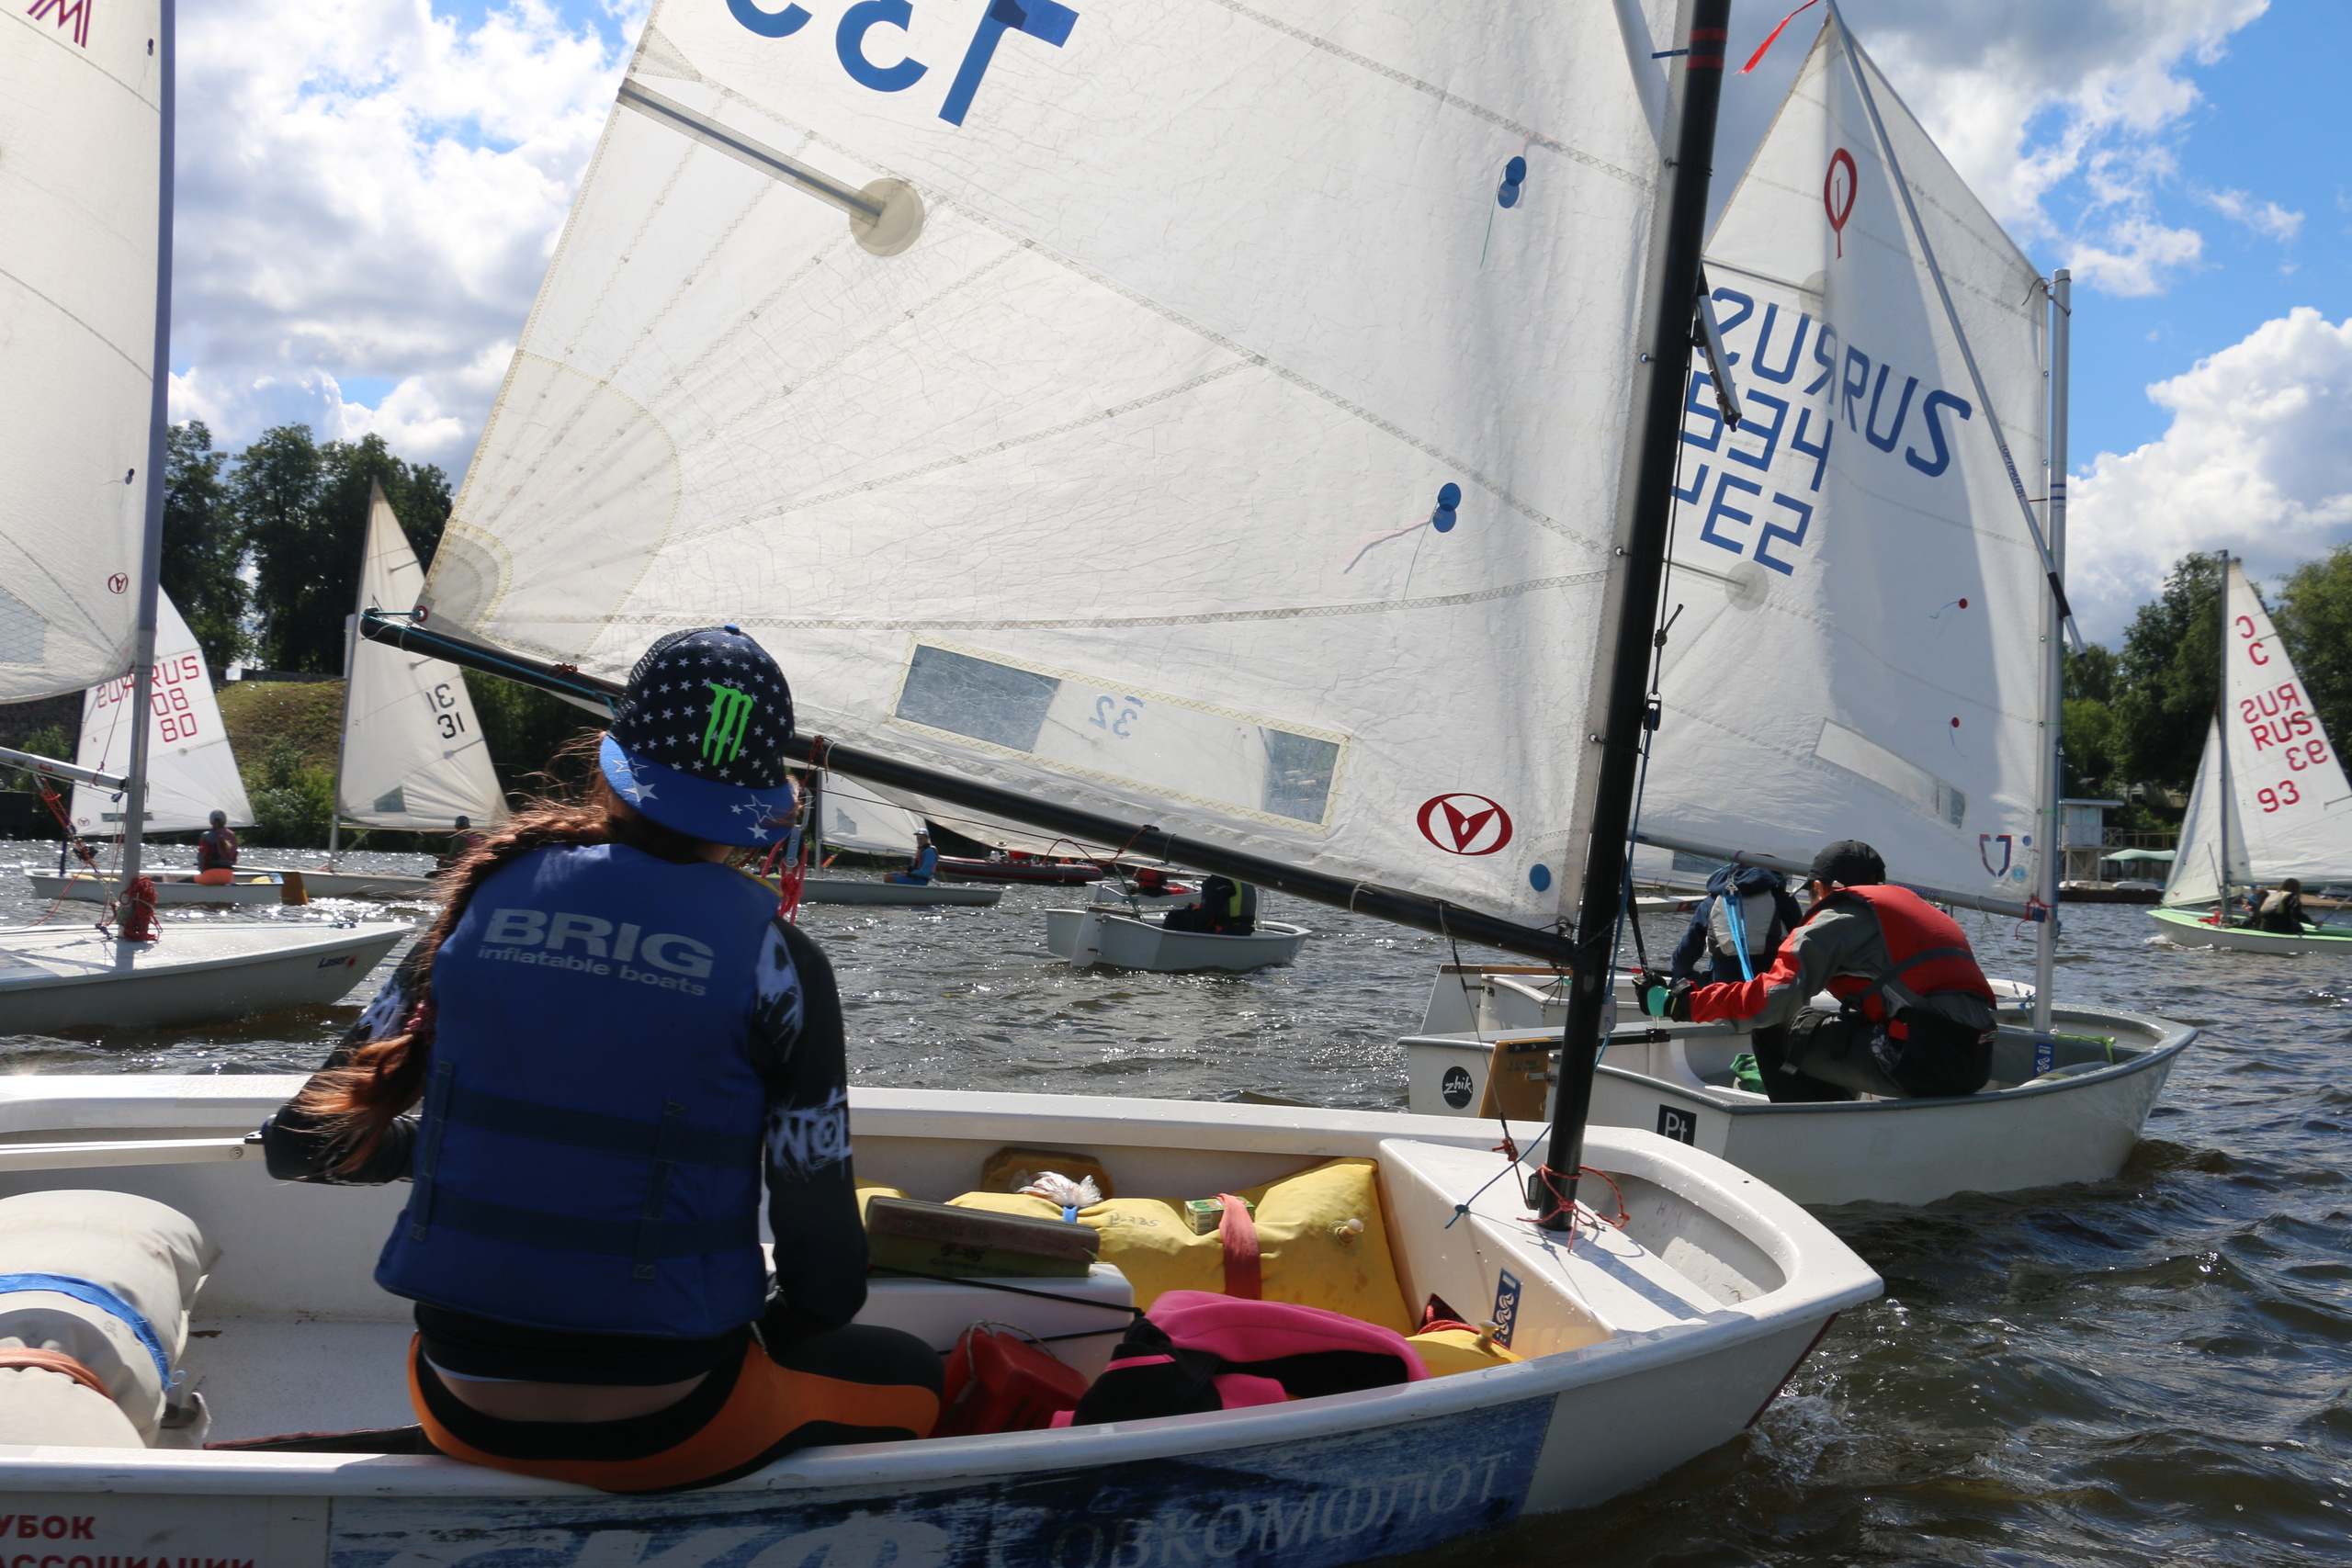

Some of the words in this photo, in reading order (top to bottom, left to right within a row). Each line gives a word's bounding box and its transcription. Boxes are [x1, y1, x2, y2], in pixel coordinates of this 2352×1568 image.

[1841, 344, 1973, 478] RUS
[2002, 447, 2025, 496] OPTIPARTS
[2248, 642, 2269, 665] C
[160, 713, 197, 743] 80
[437, 712, 465, 739] 31
[2250, 710, 2313, 751] RUS
[2257, 780, 2301, 813] 93
[483, 908, 715, 978] BRIG
[317, 955, 350, 969] Laser
[477, 945, 611, 976] inflatable
[618, 964, 707, 996] boats
[1443, 1076, 1473, 1094] zhik
